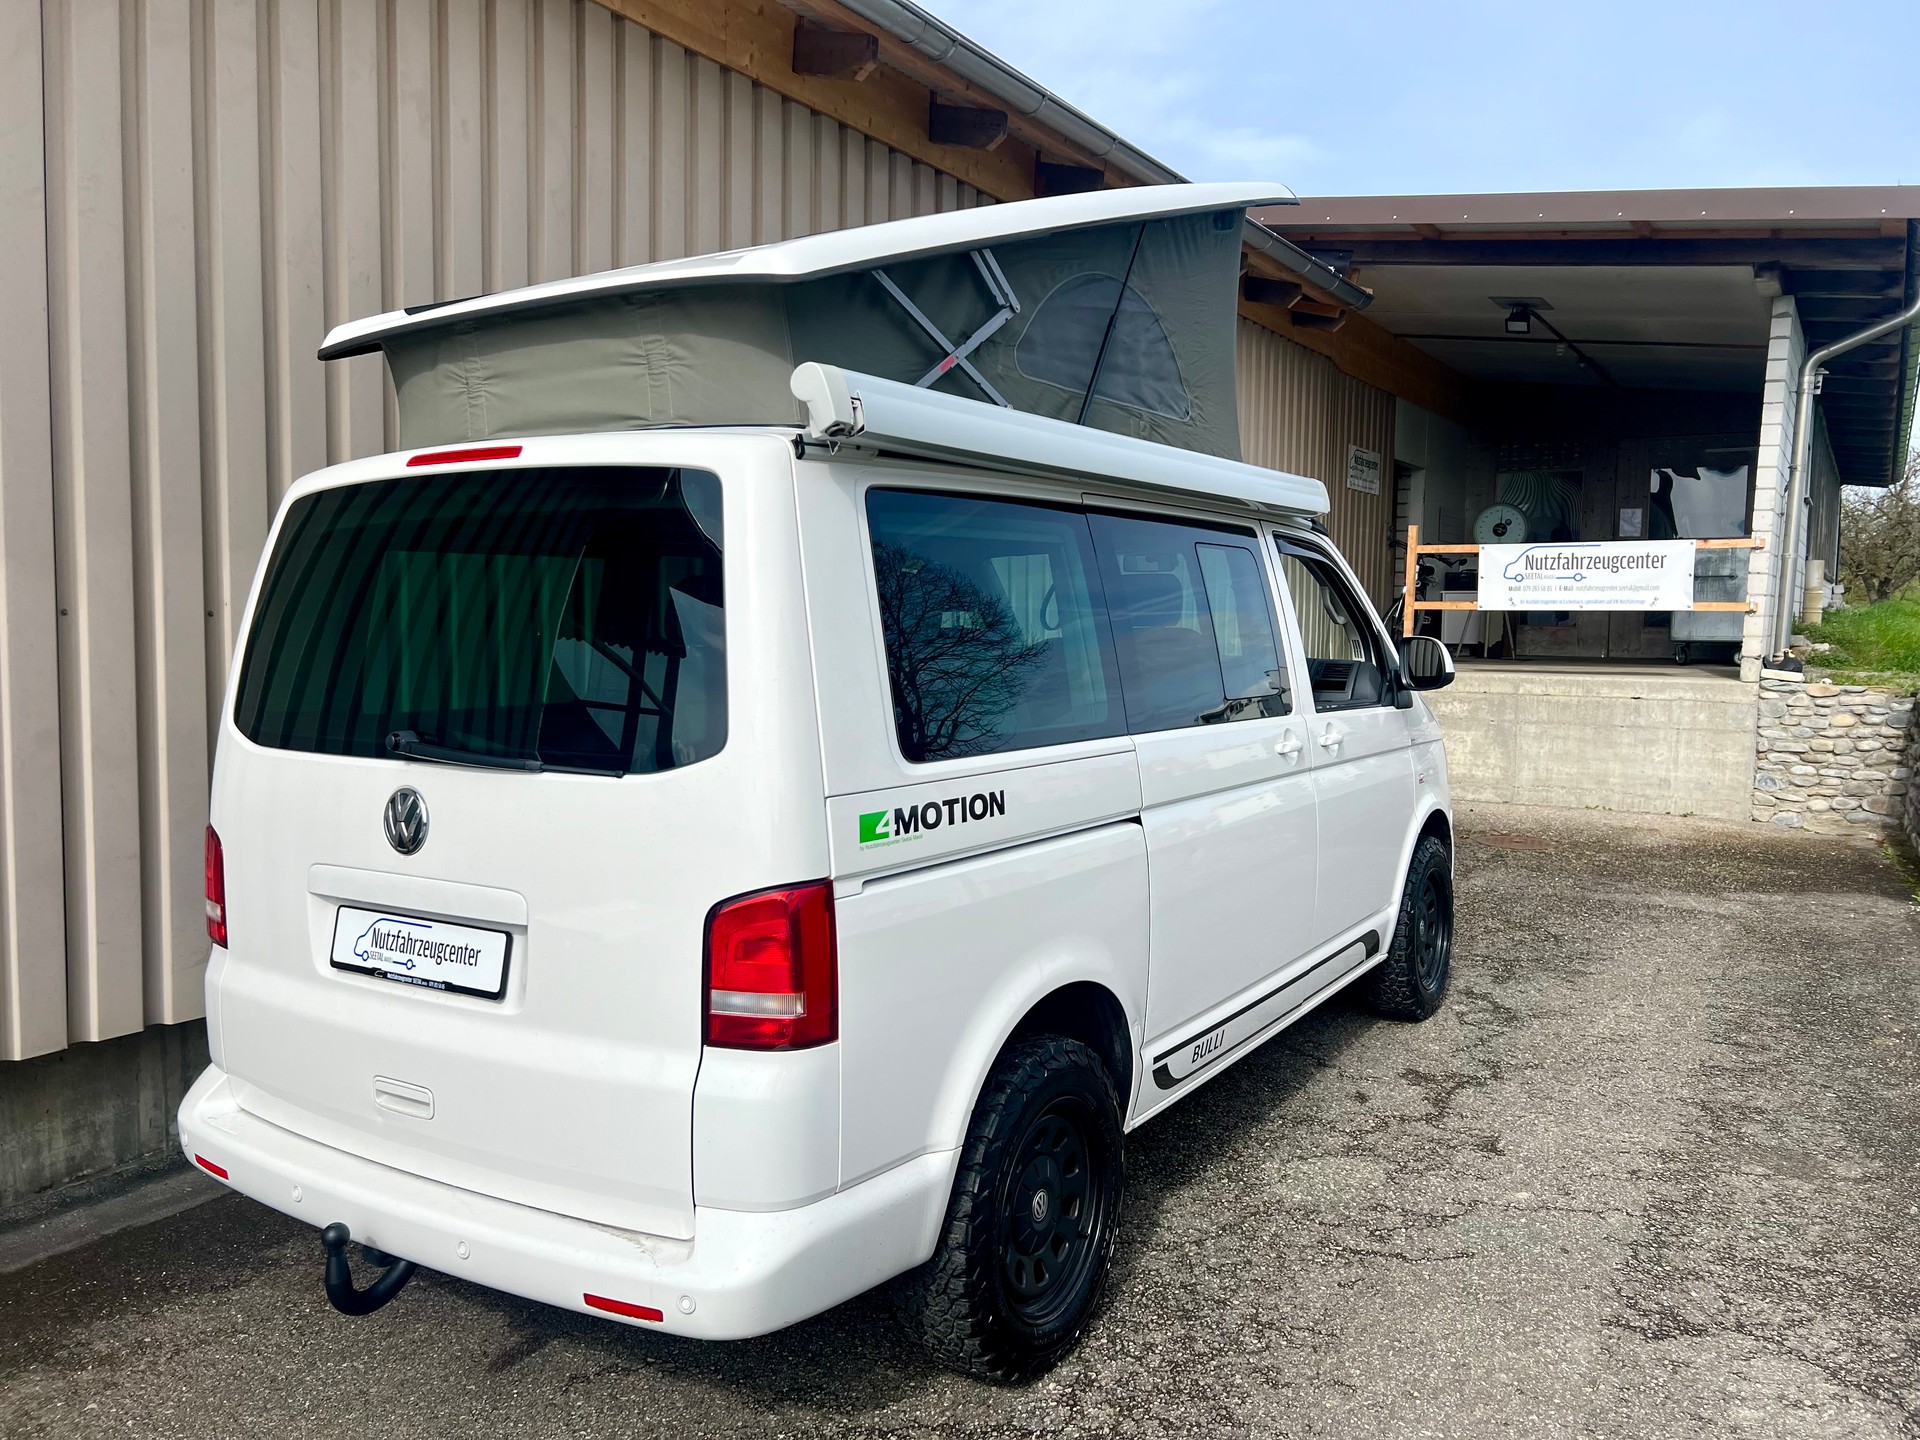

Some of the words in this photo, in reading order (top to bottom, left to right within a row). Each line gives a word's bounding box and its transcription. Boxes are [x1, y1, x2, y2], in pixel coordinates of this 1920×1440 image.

[1525, 552, 1667, 573] Nutzfahrzeugcenter
[1524, 572, 1543, 580] SEETAL
[369, 951, 384, 961] SEETAL
[371, 927, 481, 967] Nutzfahrzeugcenter
[1192, 1029, 1225, 1064] BULLI
